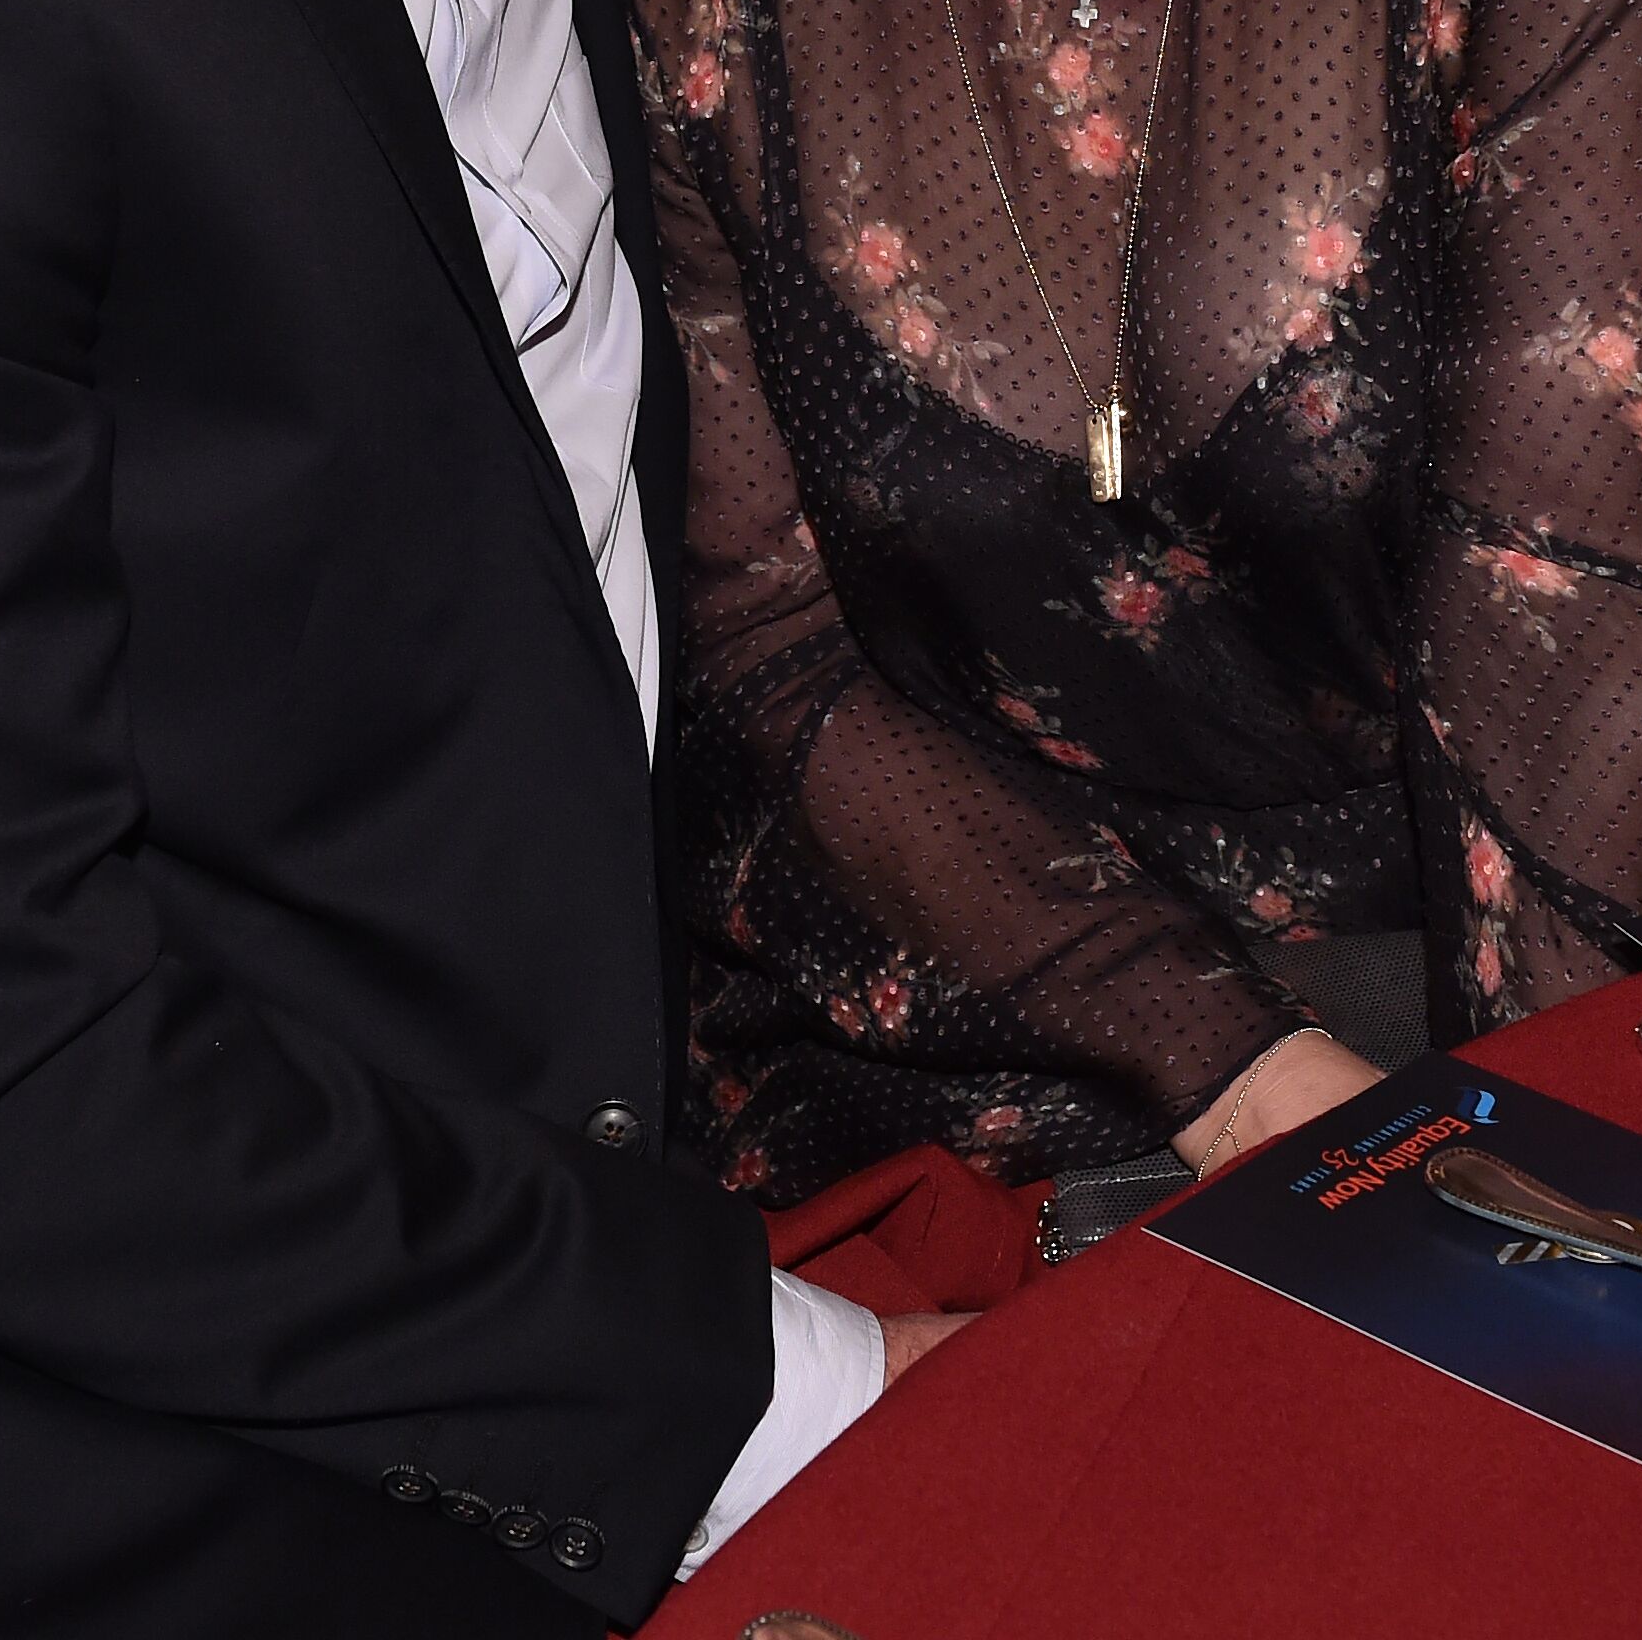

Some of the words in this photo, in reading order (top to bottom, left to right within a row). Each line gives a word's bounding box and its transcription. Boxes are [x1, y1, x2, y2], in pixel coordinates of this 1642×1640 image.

[1353, 1105, 1432, 1153] CELEBRATING
[1366, 1116, 1472, 1176] Equality
[1321, 1148, 1359, 1169] 25
[1289, 1167, 1332, 1194] YEARS
[1318, 1170, 1385, 1210] Now
